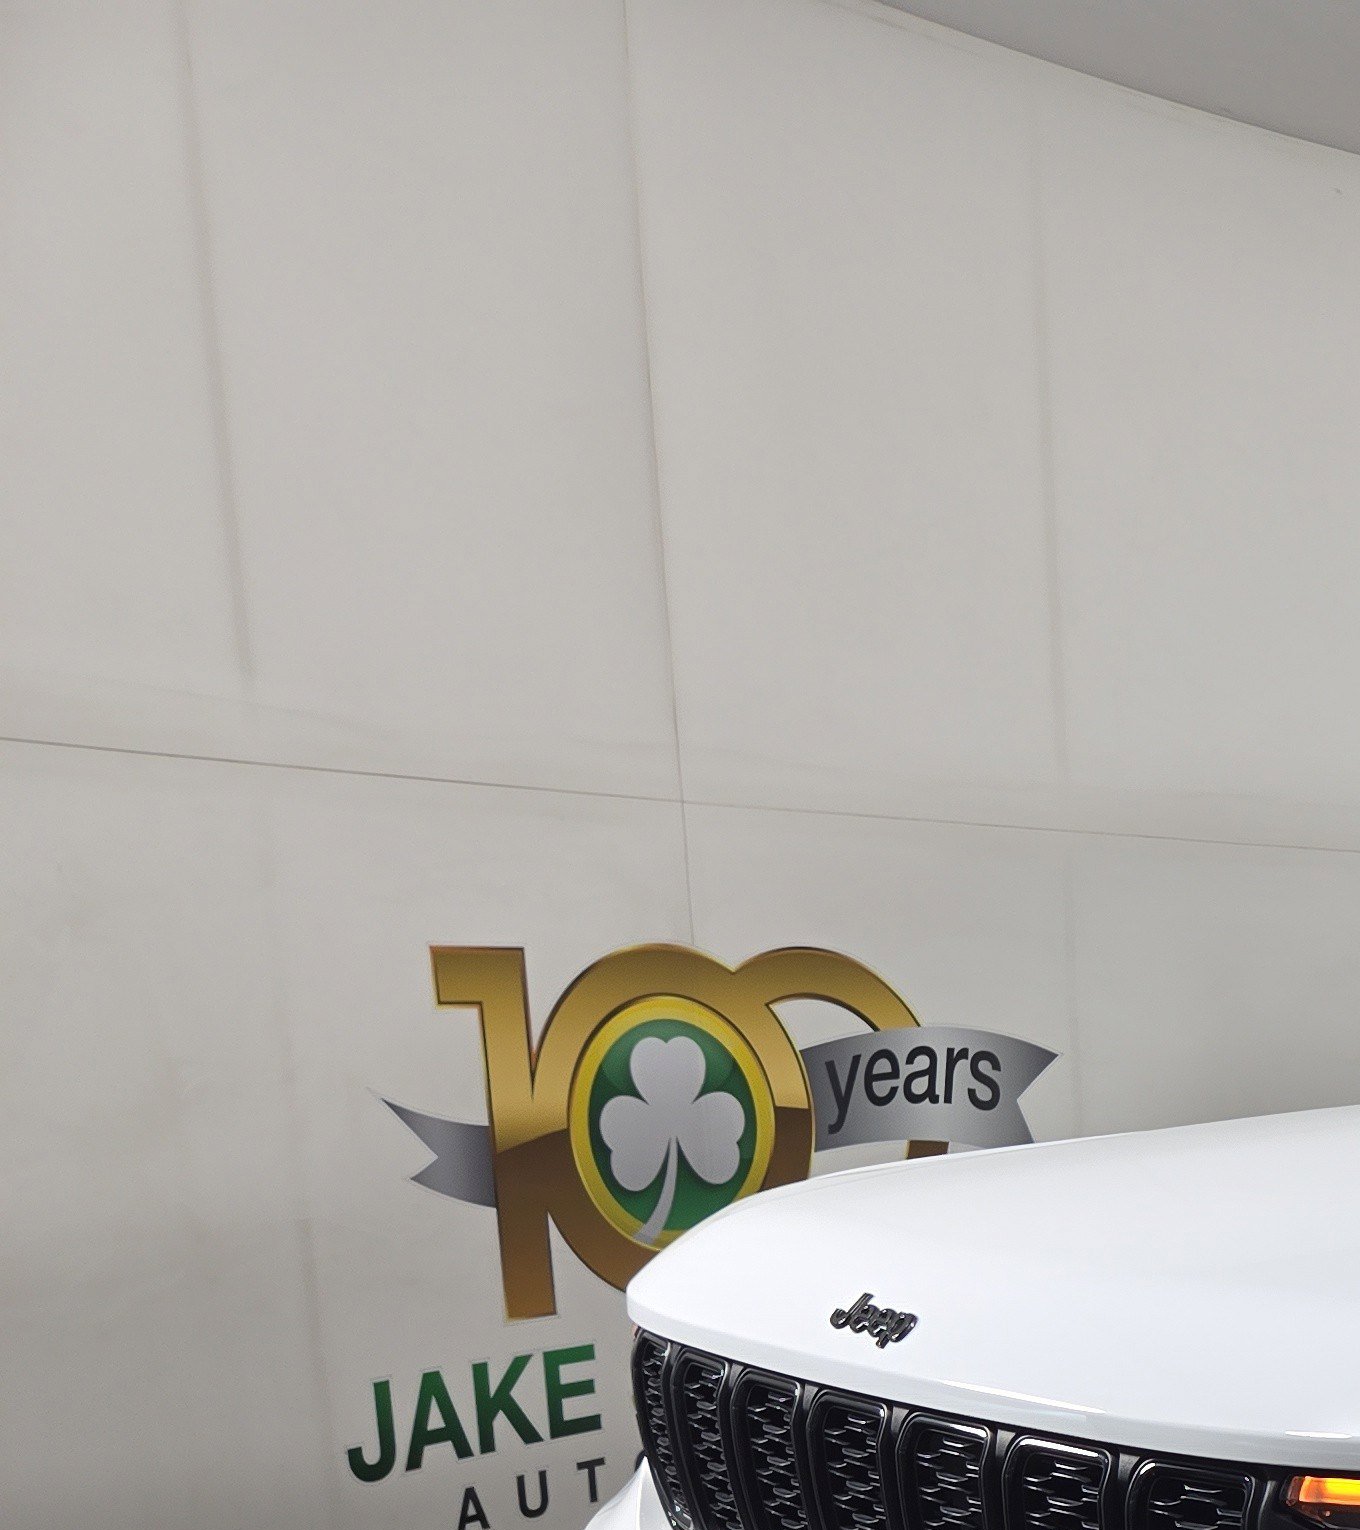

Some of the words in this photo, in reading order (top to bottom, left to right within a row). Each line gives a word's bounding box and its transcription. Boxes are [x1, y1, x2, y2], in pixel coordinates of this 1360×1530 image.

[826, 1045, 1002, 1136] years
[830, 1292, 919, 1349] Jeep
[347, 1343, 603, 1483] JAKE
